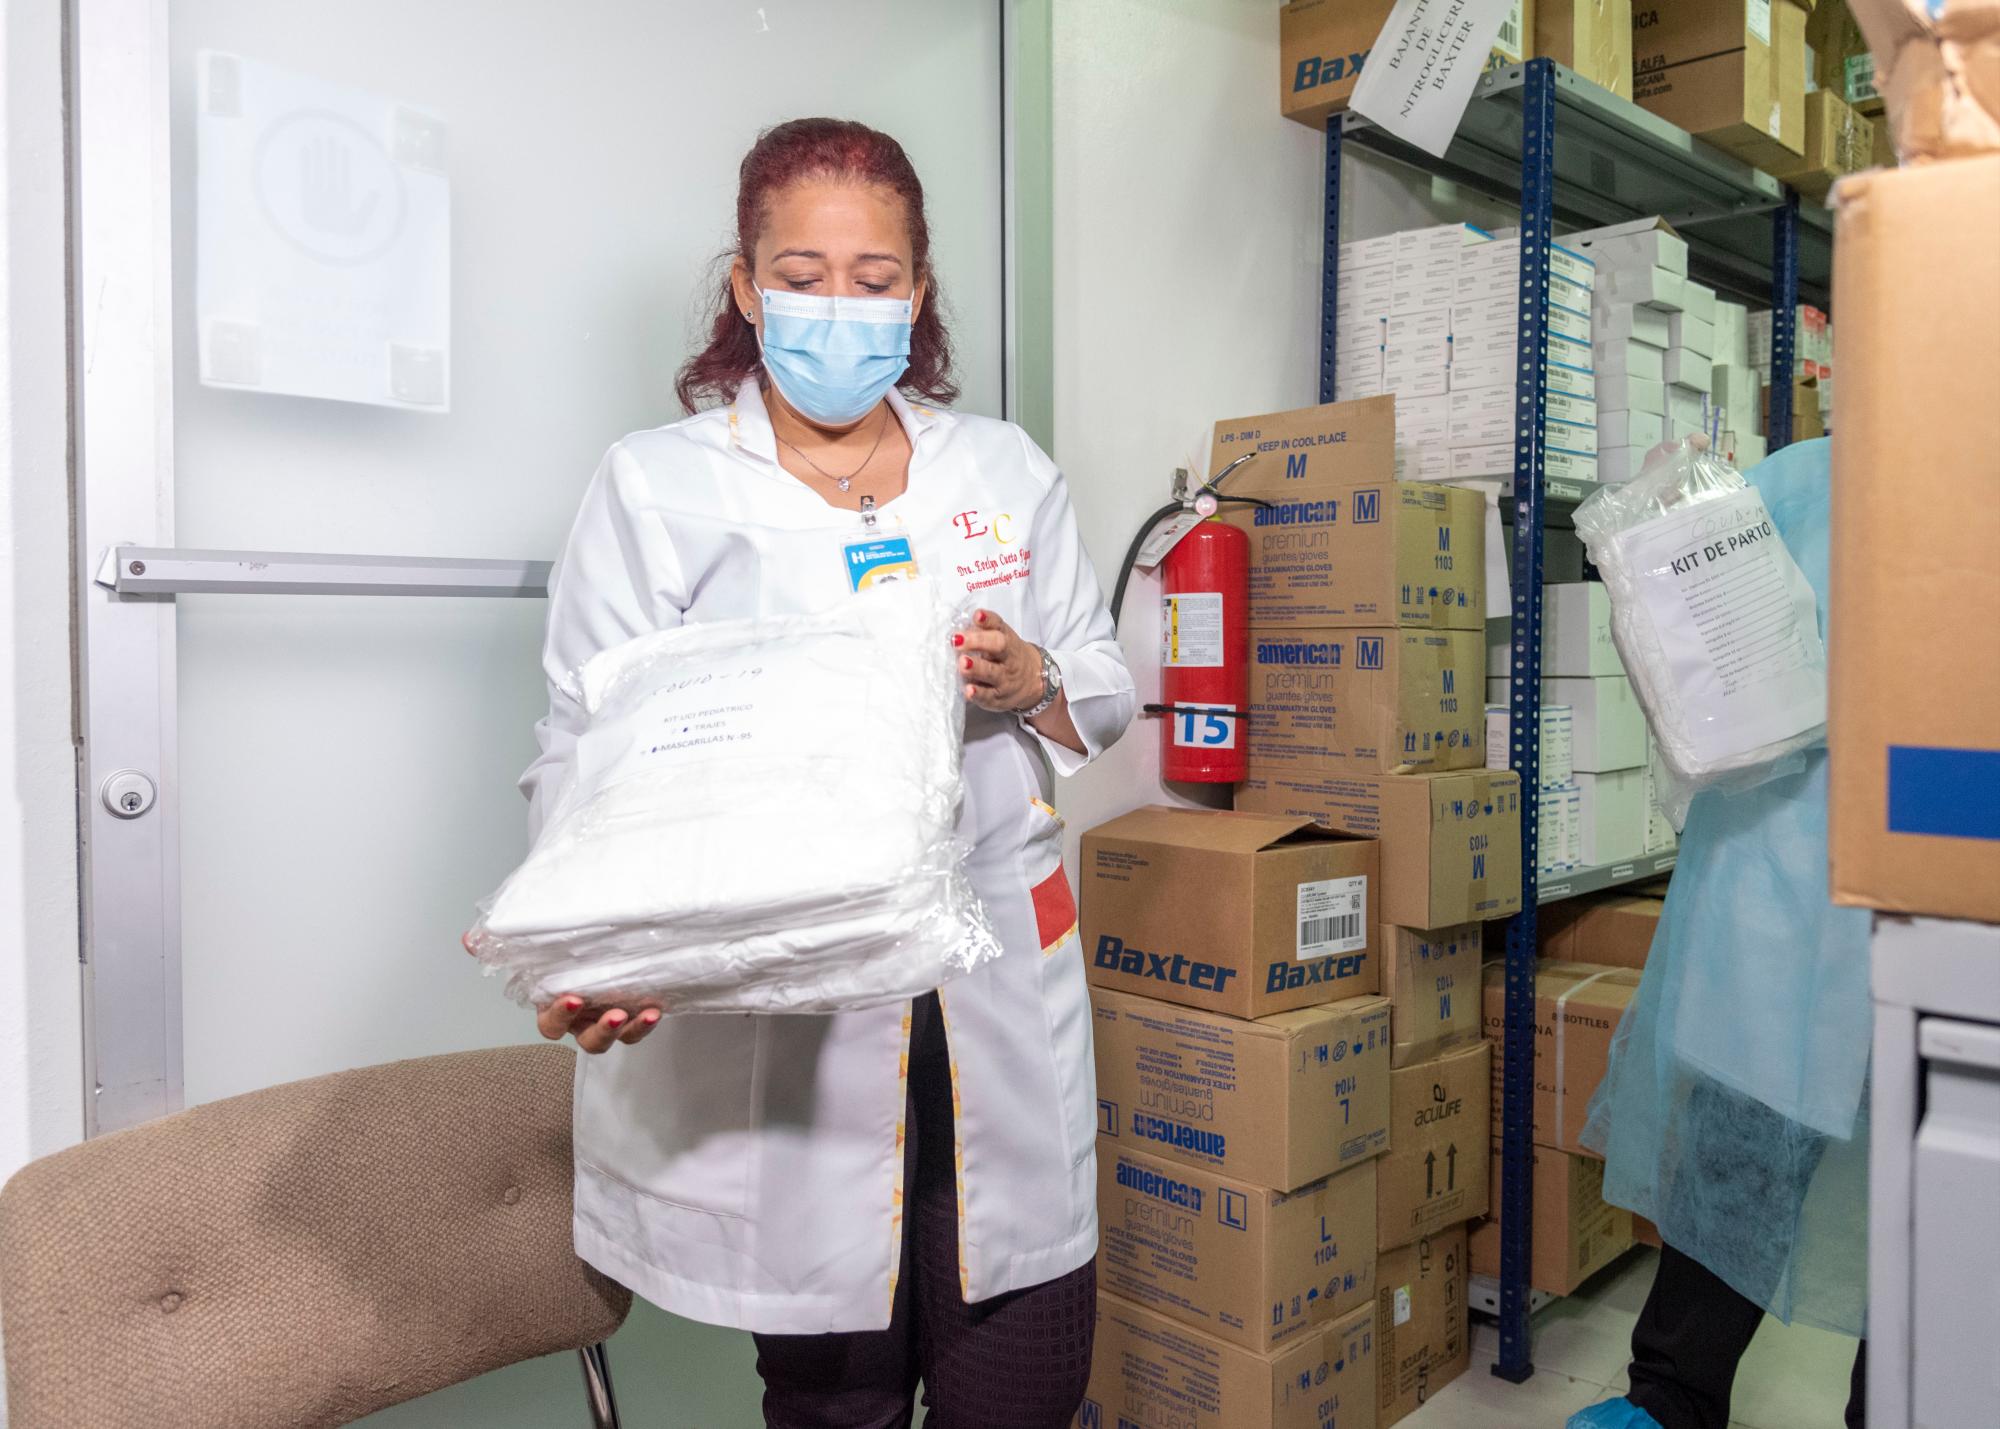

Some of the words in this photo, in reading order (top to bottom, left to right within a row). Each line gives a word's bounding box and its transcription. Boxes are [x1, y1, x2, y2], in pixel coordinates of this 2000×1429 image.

[1416, 27, 1433, 51] DE
[1400, 0, 1465, 118] NITROGLICERI
[1432, 21, 1474, 90] BAXTER
[1293, 48, 1371, 92] Bax
[1257, 440, 1280, 452] KEEP
[1282, 440, 1289, 449] IN
[1292, 437, 1316, 448] COOL
[1318, 431, 1347, 444] PLACE
[1286, 453, 1308, 479] M
[1254, 500, 1337, 527] american
[1357, 494, 1376, 520] M
[953, 511, 988, 540] E
[992, 513, 1016, 544] C
[1439, 527, 1450, 551] M
[1263, 531, 1329, 554] premium
[1671, 552, 1700, 575] KIT
[1703, 541, 1727, 562] DE
[1727, 521, 1771, 551] PARTO
[1248, 566, 1261, 574] ATEX
[1264, 564, 1305, 573] EXAMINATION
[1306, 563, 1333, 572] GLOVES
[1435, 555, 1453, 570] 1103
[1257, 643, 1341, 665] american
[1361, 641, 1379, 666] M
[1265, 673, 1334, 691] premium
[1443, 669, 1454, 694] M
[664, 715, 679, 723] KIT
[698, 704, 753, 717] PEDIATRICO
[1267, 705, 1310, 713] EXAMINATION
[1440, 699, 1457, 713] 1103
[695, 721, 726, 731] TRAJES
[1179, 706, 1230, 745] 15
[660, 735, 724, 751] MASCARILLAS
[1470, 834, 1488, 850] 1103
[1473, 854, 1485, 880] M
[1094, 934, 1237, 993] Baxter
[1265, 954, 1367, 994] Baxter
[1437, 976, 1454, 992] 1103
[1439, 994, 1450, 1020] M
[1563, 1014, 1610, 1029] BOTTLES
[1136, 1062, 1163, 1075] GLOVES
[1164, 1069, 1212, 1086] EXAMINATION
[1196, 1060, 1231, 1071] NON-STERILE
[1200, 1069, 1231, 1079] POWDERED
[1140, 1075, 1214, 1101] guantes/gloves
[1212, 1080, 1236, 1092] LATEX
[1335, 1076, 1356, 1097] 1104
[1100, 1103, 1112, 1131] L
[1140, 1088, 1214, 1122] premium
[1340, 1099, 1349, 1125] L
[1134, 1114, 1226, 1158] american
[1116, 1162, 1201, 1211] american
[1124, 1199, 1194, 1236] premium
[1227, 1194, 1240, 1225] L
[1125, 1219, 1194, 1250] guantes/gloves
[1321, 1215, 1332, 1243] L
[1105, 1225, 1124, 1240] LATEX
[1126, 1232, 1169, 1254] EXAMINATION
[1169, 1249, 1198, 1265] GLOVES
[1314, 1243, 1338, 1266] 1104
[1121, 1367, 1148, 1386] GLOVES
[1149, 1380, 1196, 1405] EXAMINATION
[1318, 1394, 1339, 1420] 1103
